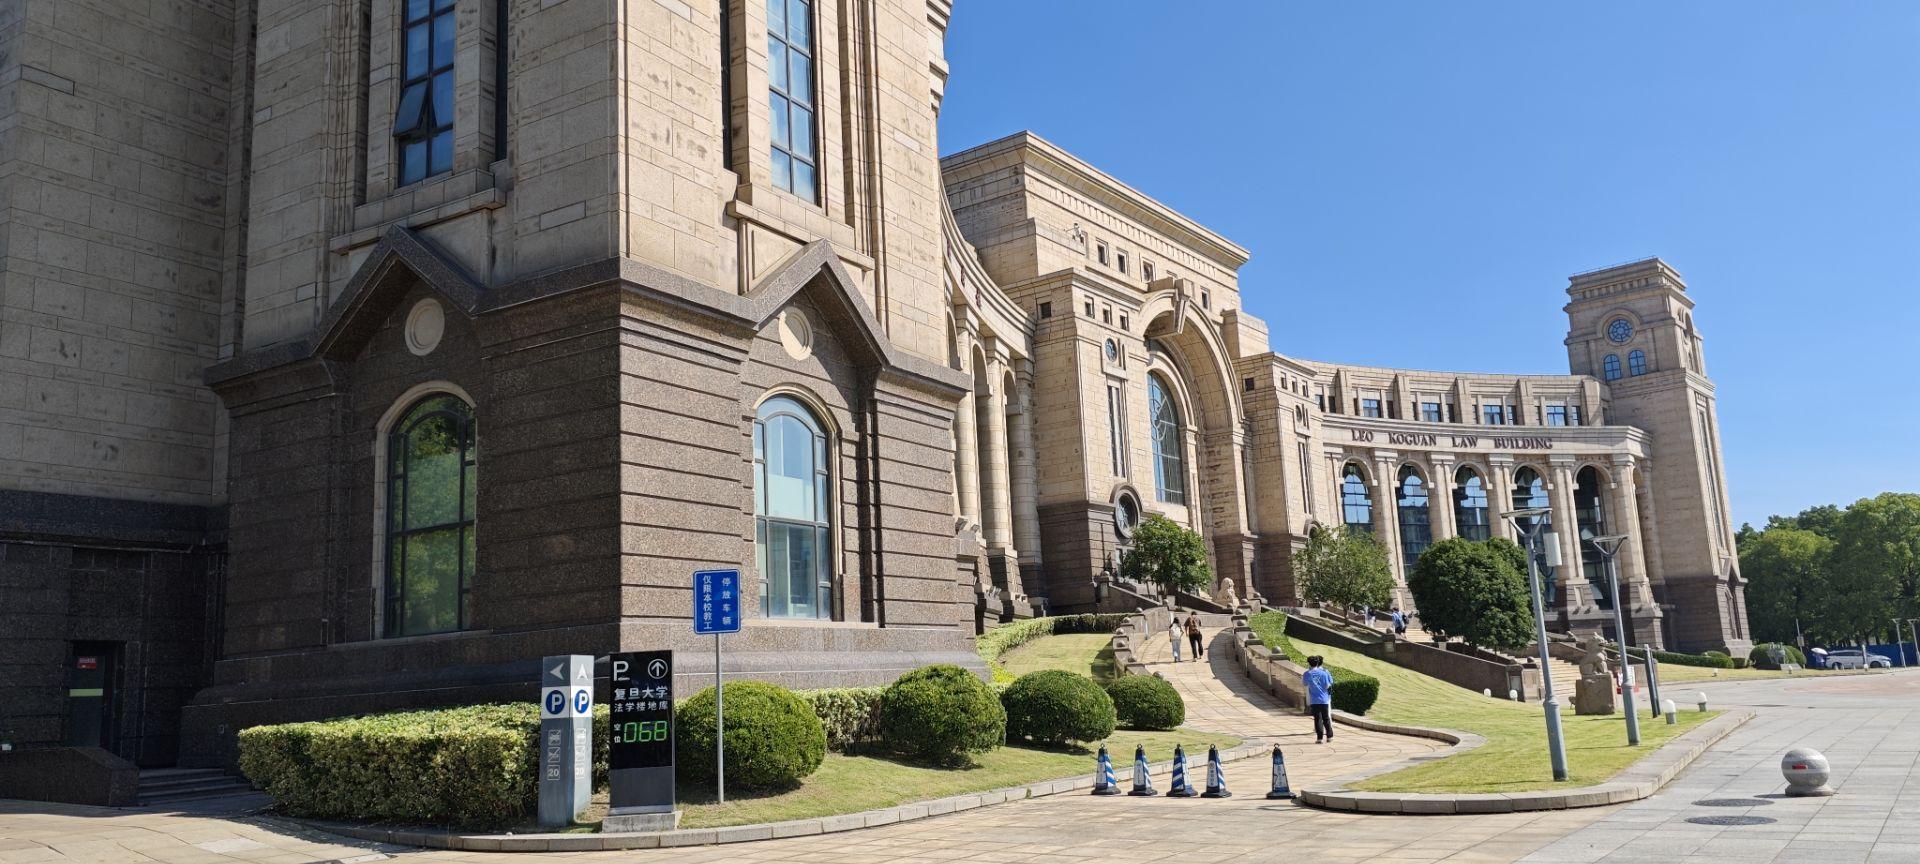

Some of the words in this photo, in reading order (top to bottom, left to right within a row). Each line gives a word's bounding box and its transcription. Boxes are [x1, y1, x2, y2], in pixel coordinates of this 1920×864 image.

[1351, 429, 1374, 442] LEO
[1389, 432, 1437, 446] KOGUAN
[1451, 435, 1479, 448] LAW
[1493, 436, 1553, 450] BUILDING
[702, 575, 713, 630] 仅限本校教工
[721, 577, 732, 625] 停放车辆
[613, 660, 628, 682] P
[551, 693, 563, 712] P
[578, 692, 588, 711] P
[614, 685, 668, 701] 复旦大学
[614, 701, 669, 713] 法学楼地库
[613, 722, 622, 744] 空位
[623, 720, 668, 743] 068
[547, 768, 560, 777] 20
